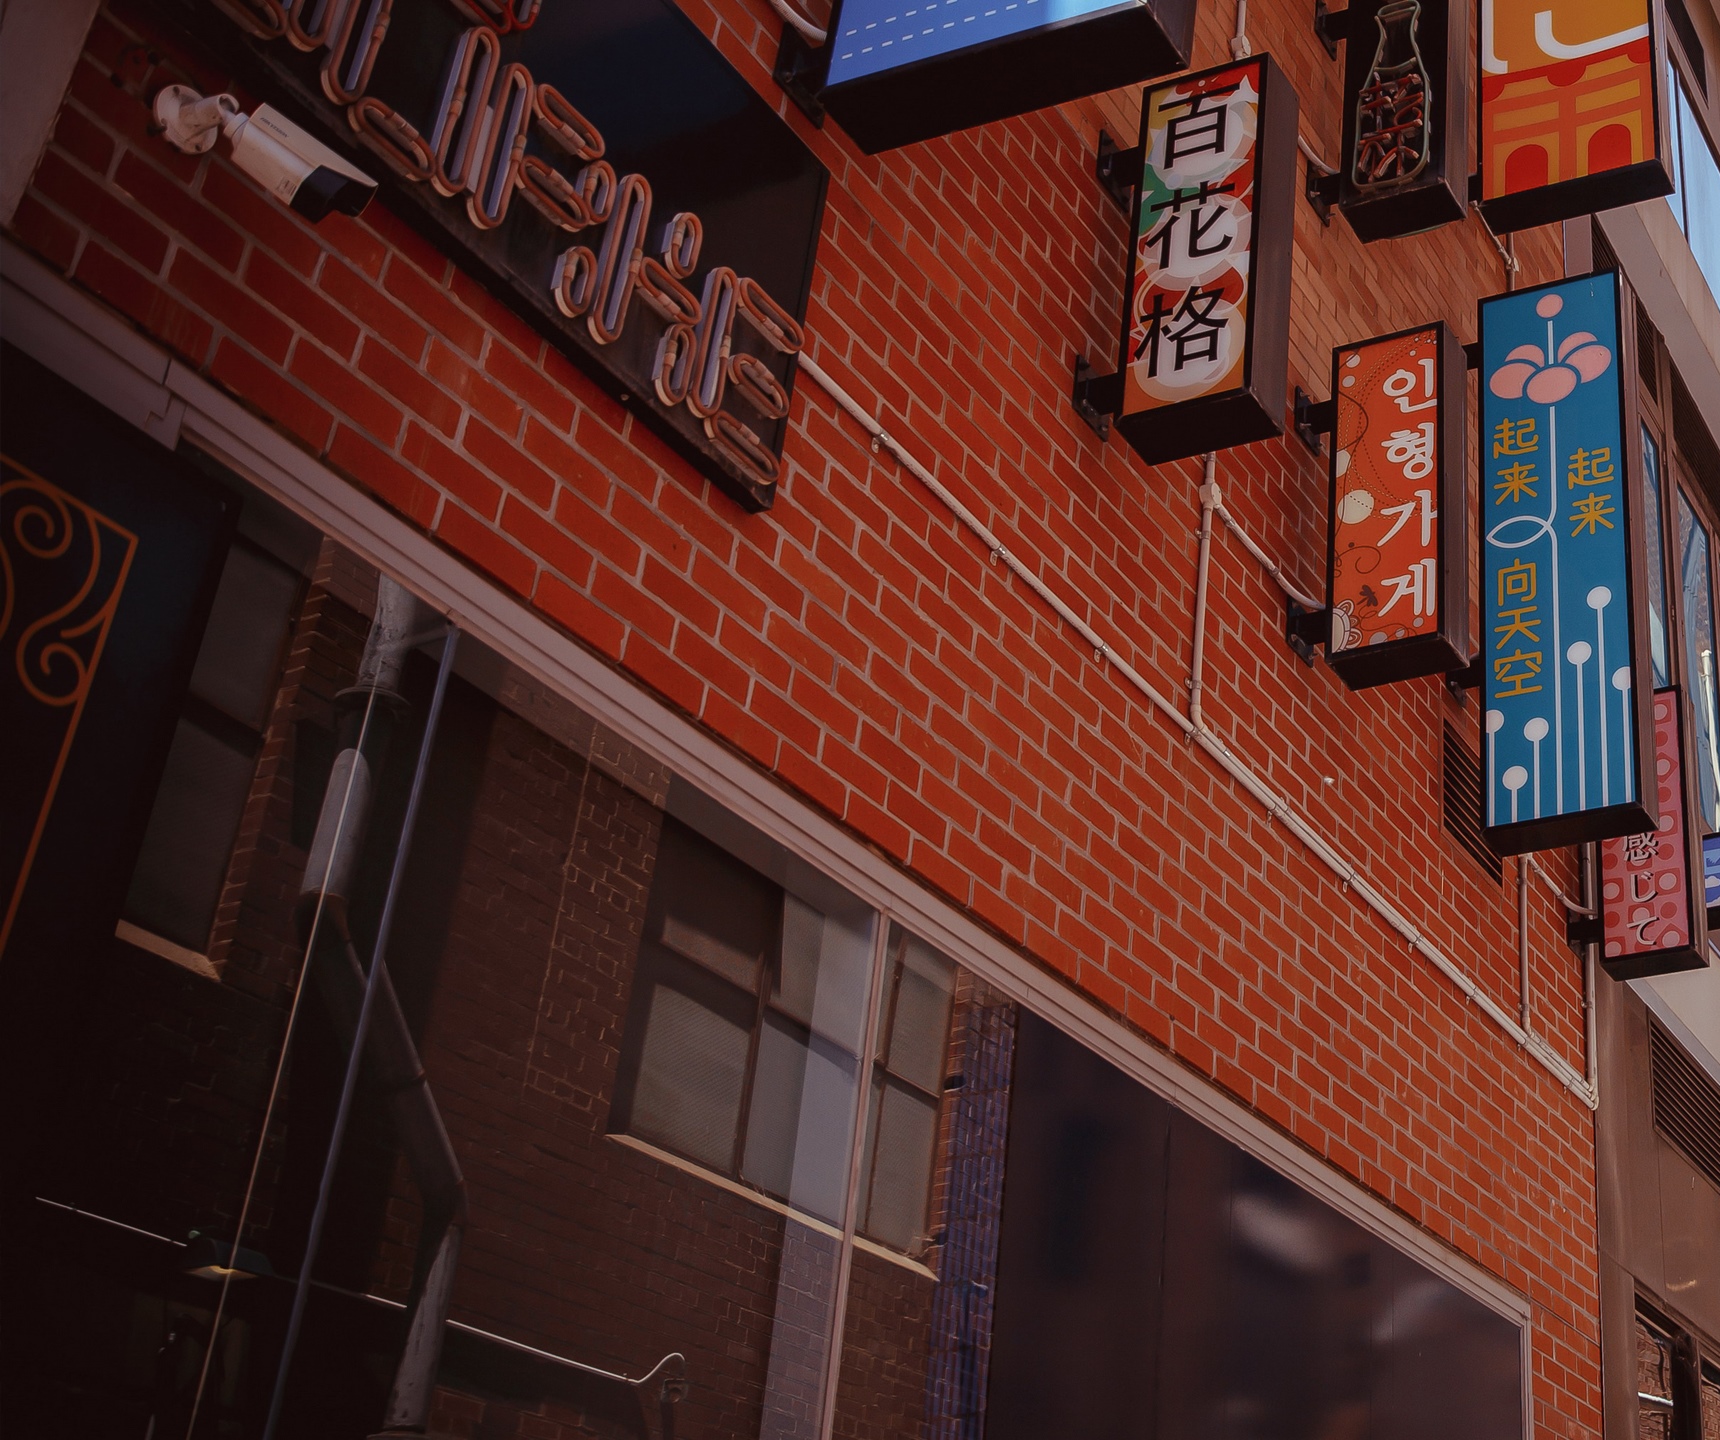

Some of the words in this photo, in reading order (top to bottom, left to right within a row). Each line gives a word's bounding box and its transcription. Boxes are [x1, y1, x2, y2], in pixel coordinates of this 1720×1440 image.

[208, 0, 804, 485] URKE
[1134, 83, 1240, 379] 百花格
[1377, 358, 1438, 618] 인형가게
[1493, 417, 1540, 506] 起来
[1567, 446, 1616, 538] 起来
[1493, 557, 1543, 699] 向天空
[1622, 831, 1659, 946] 感じて
